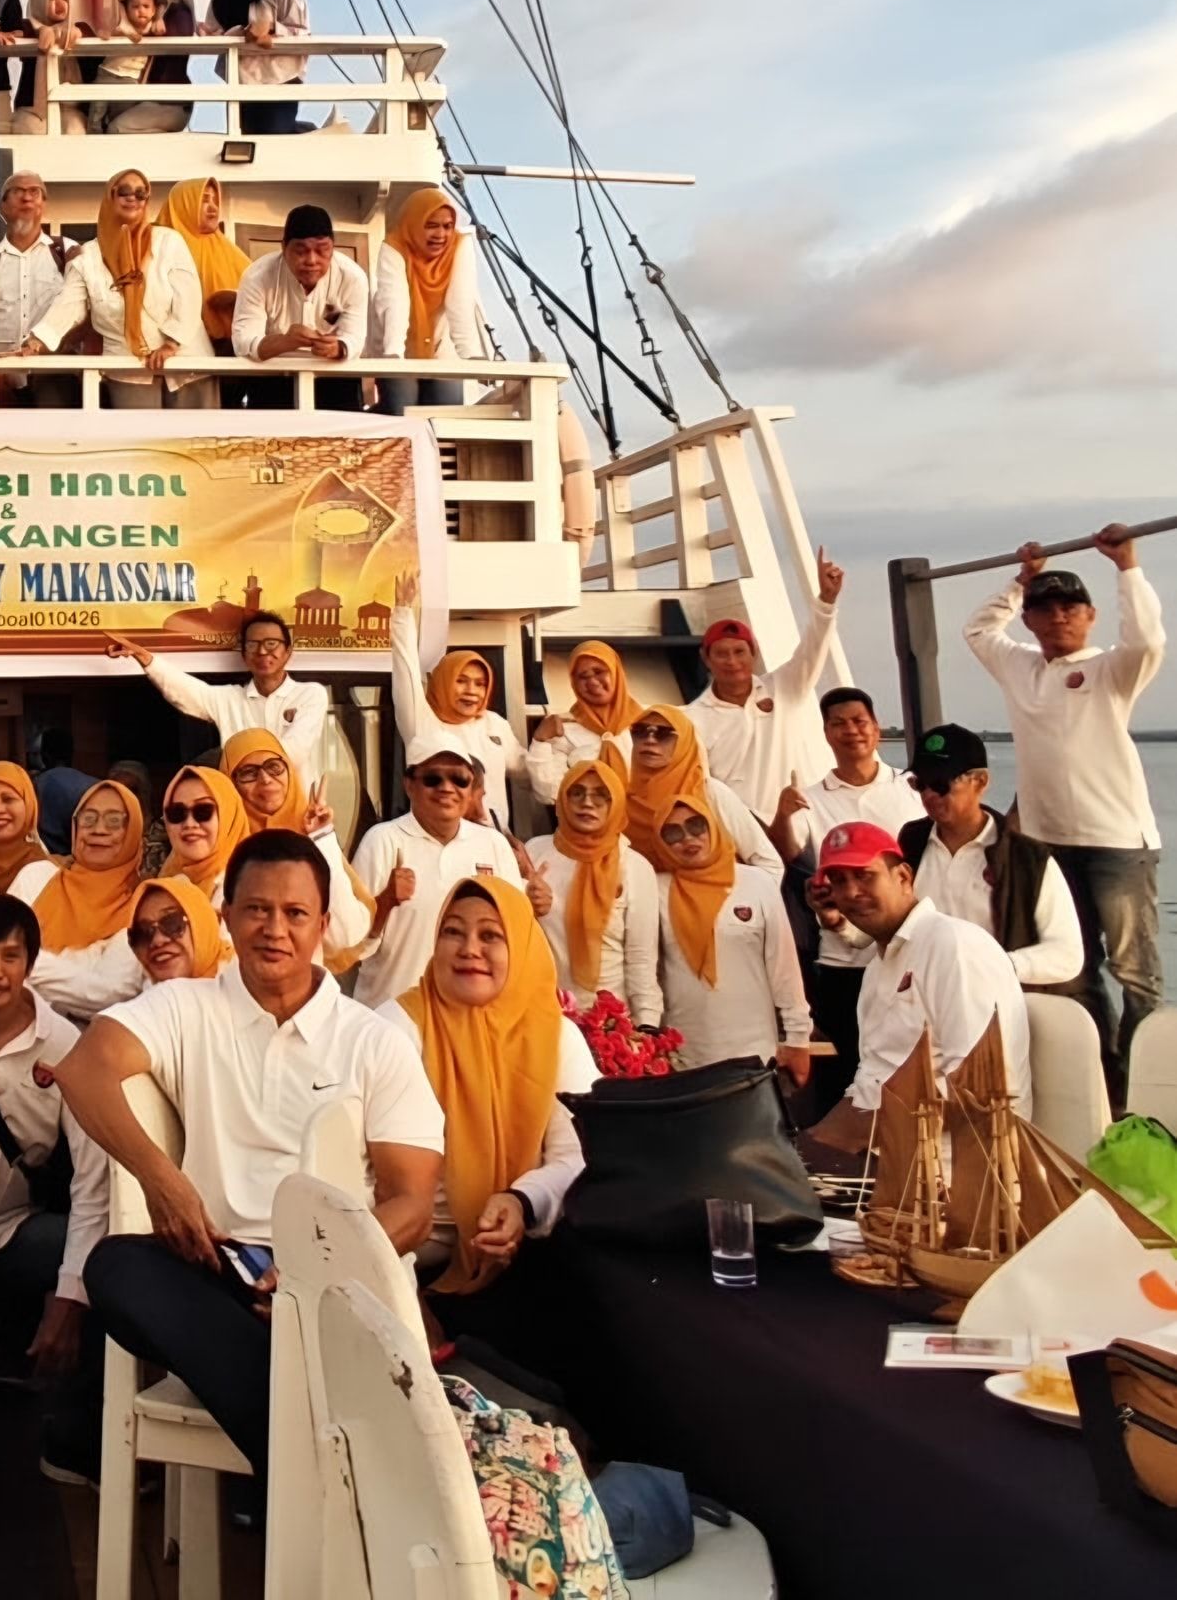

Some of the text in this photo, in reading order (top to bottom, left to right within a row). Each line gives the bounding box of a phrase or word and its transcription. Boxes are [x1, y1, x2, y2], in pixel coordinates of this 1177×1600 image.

[50, 473, 187, 497] HALAL
[0, 503, 17, 519] &
[20, 562, 196, 602] MAKASSAR
